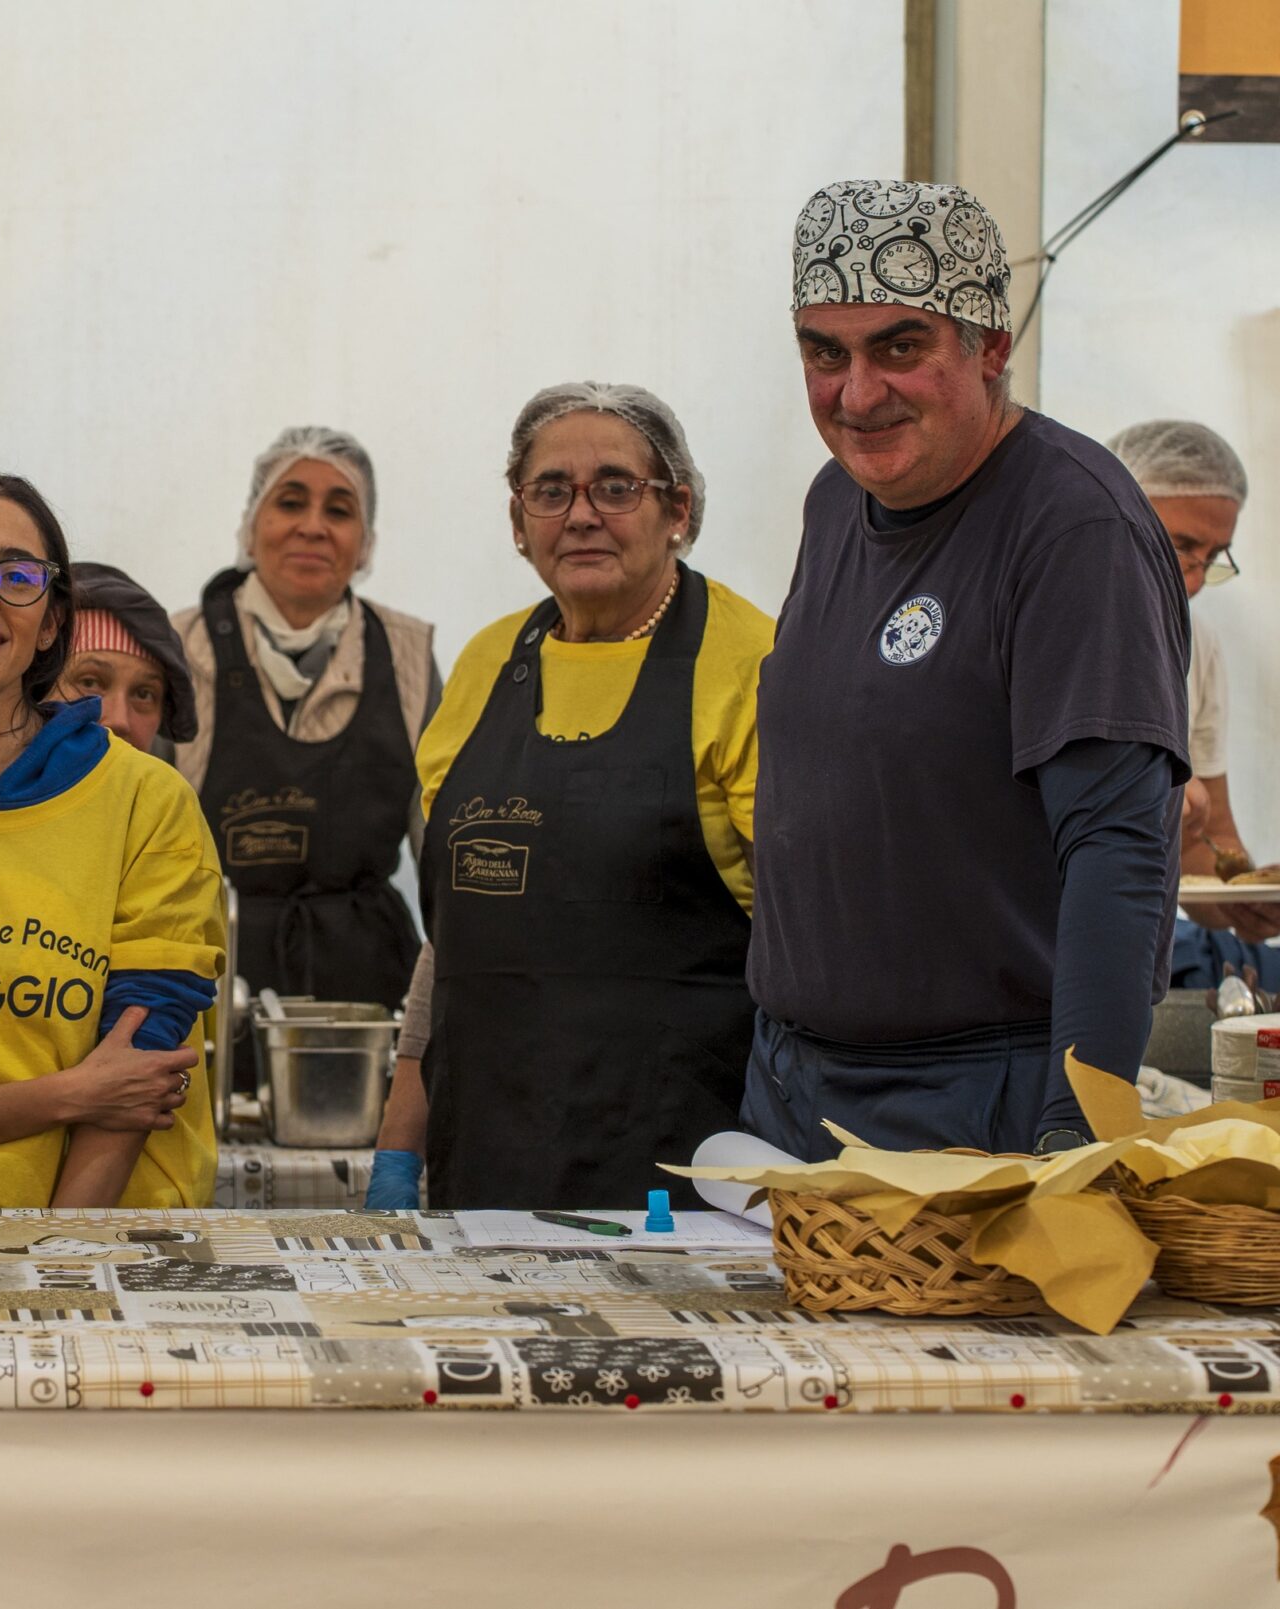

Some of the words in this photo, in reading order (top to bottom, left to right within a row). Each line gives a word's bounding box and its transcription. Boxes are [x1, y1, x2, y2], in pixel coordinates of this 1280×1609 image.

[907, 598, 935, 611] CASCIANA
[930, 608, 941, 636] POGGIO
[22, 918, 110, 977] Paesan
